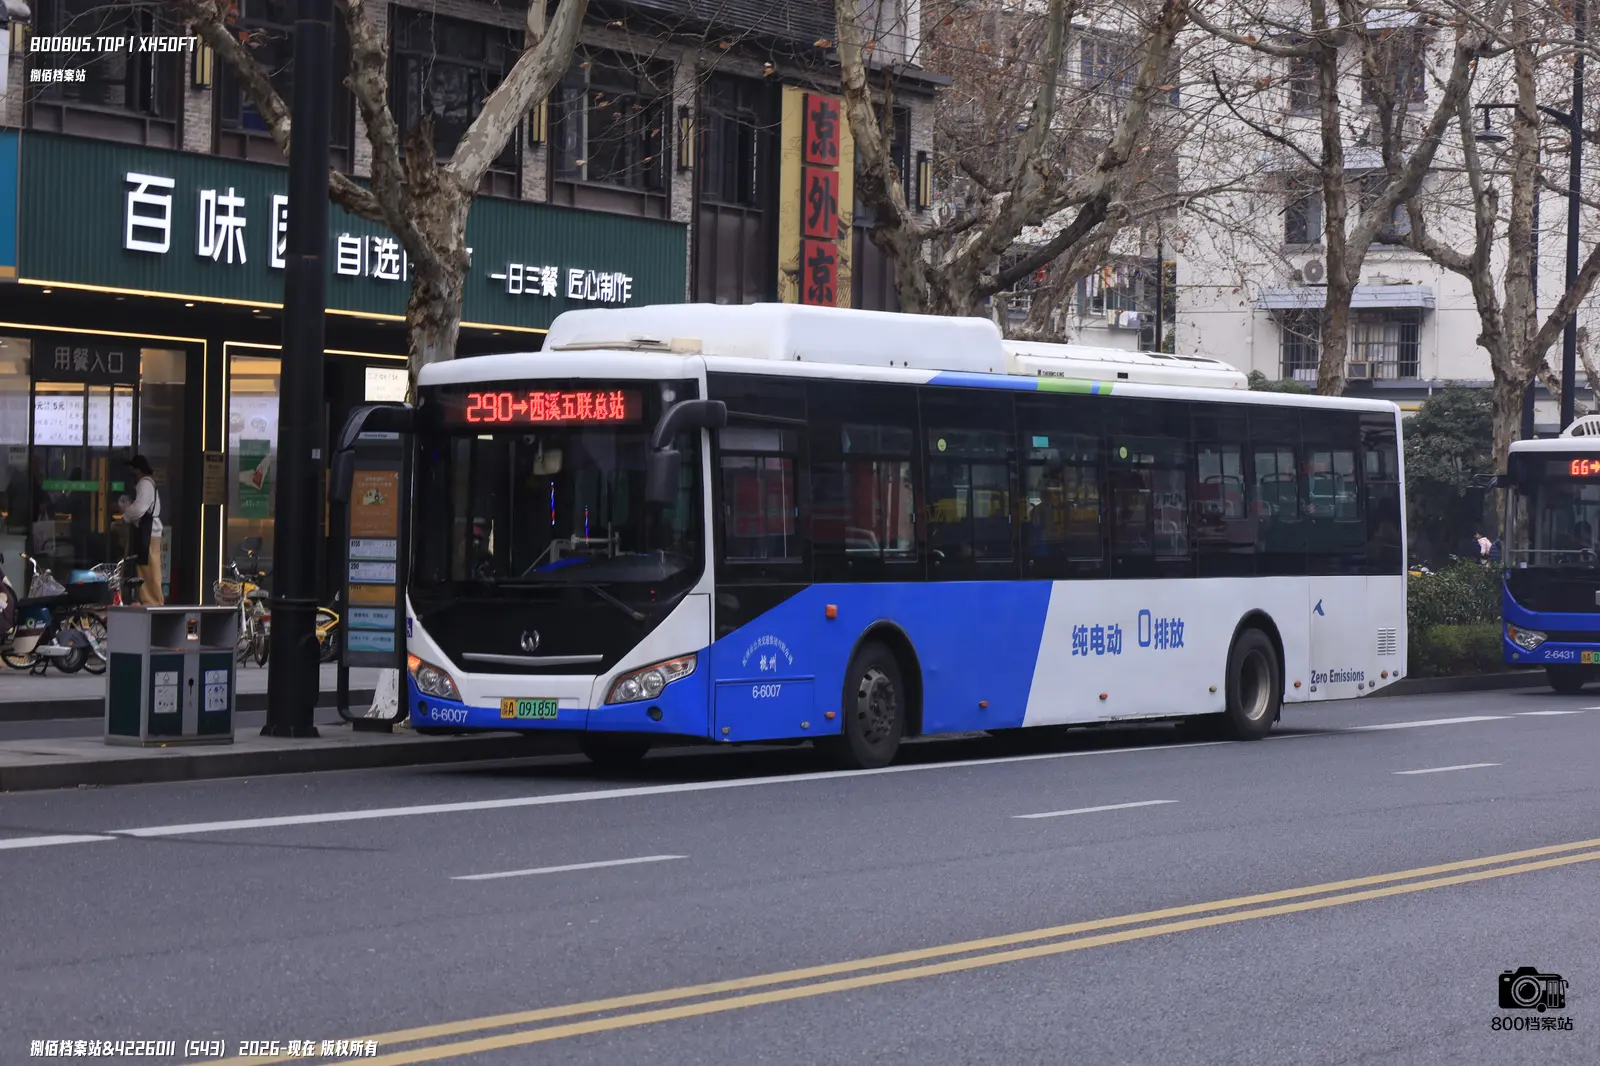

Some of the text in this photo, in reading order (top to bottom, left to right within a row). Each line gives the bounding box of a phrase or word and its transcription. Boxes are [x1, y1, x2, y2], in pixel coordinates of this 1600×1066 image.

[490, 263, 633, 303] 一日三餐 匠心制作
[54, 346, 124, 373] 用餐入口
[466, 390, 625, 422] 290 西溪五联总站
[1571, 459, 1589, 475] 66
[1072, 623, 1122, 656] 纯电动
[1544, 650, 1575, 659] 2-6431
[1310, 668, 1365, 684] Zero Emissions
[752, 684, 781, 698] 6-6007
[431, 707, 468, 723] 6-6007
